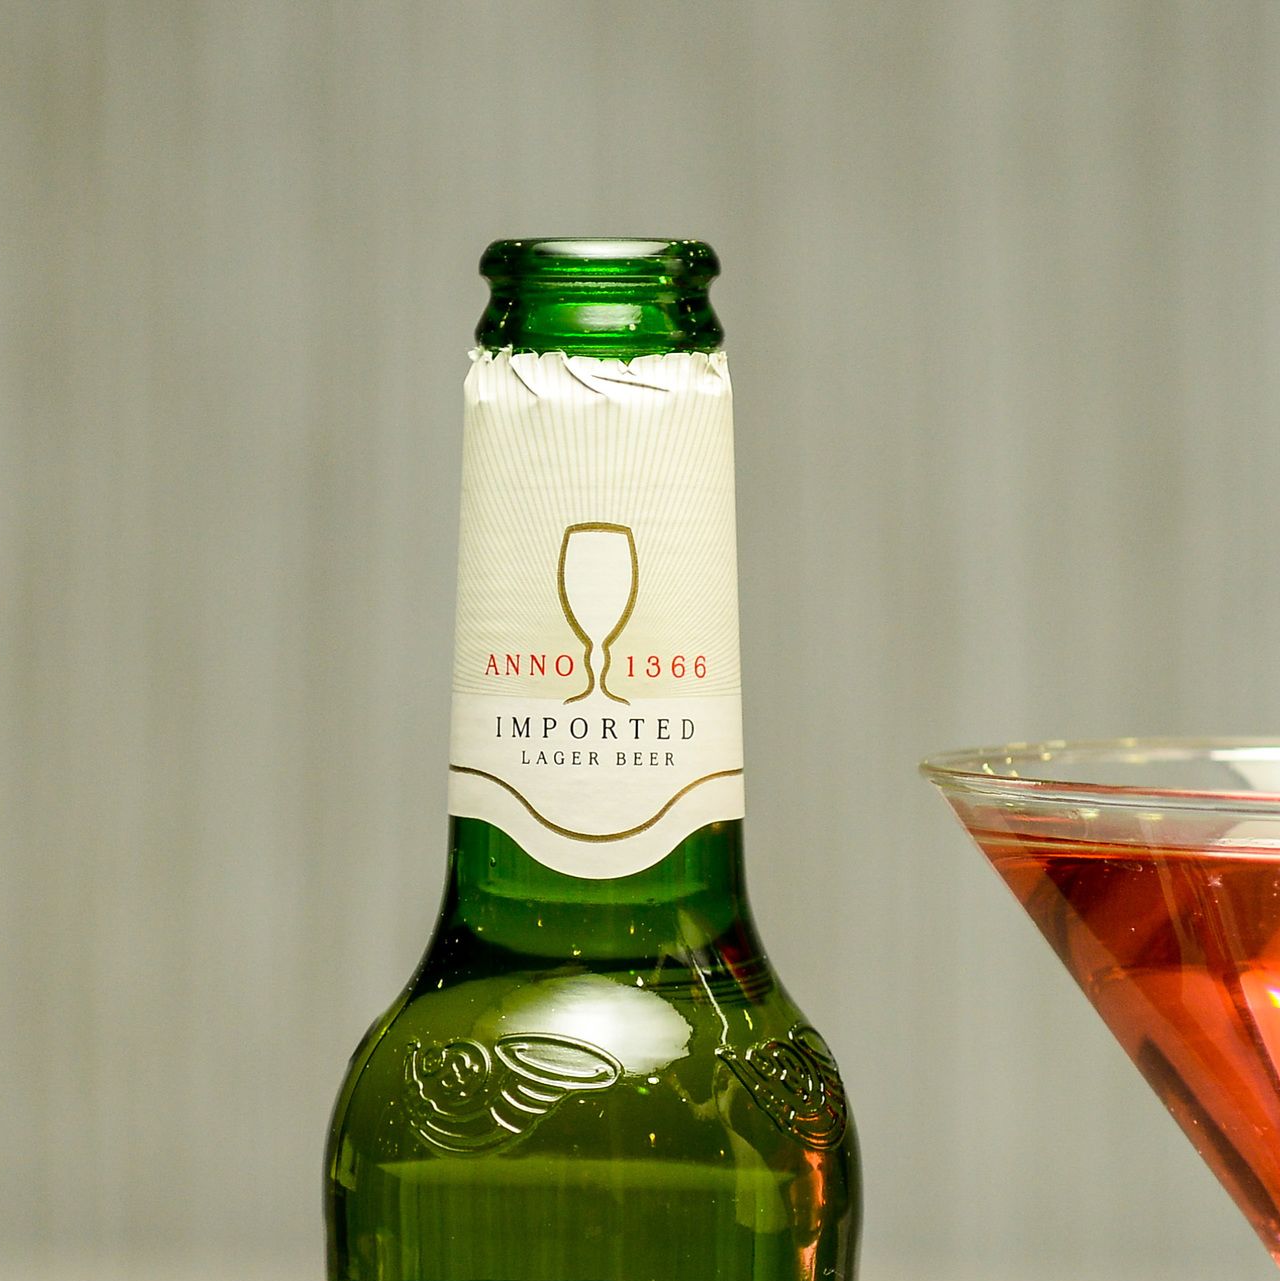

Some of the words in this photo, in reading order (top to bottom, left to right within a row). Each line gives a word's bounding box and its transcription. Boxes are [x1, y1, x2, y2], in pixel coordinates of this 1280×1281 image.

[484, 653, 575, 677] ANNO
[626, 654, 708, 679] 1366
[495, 715, 697, 742] IMPORTED
[521, 749, 601, 767] LAGER
[615, 751, 676, 768] BEER
